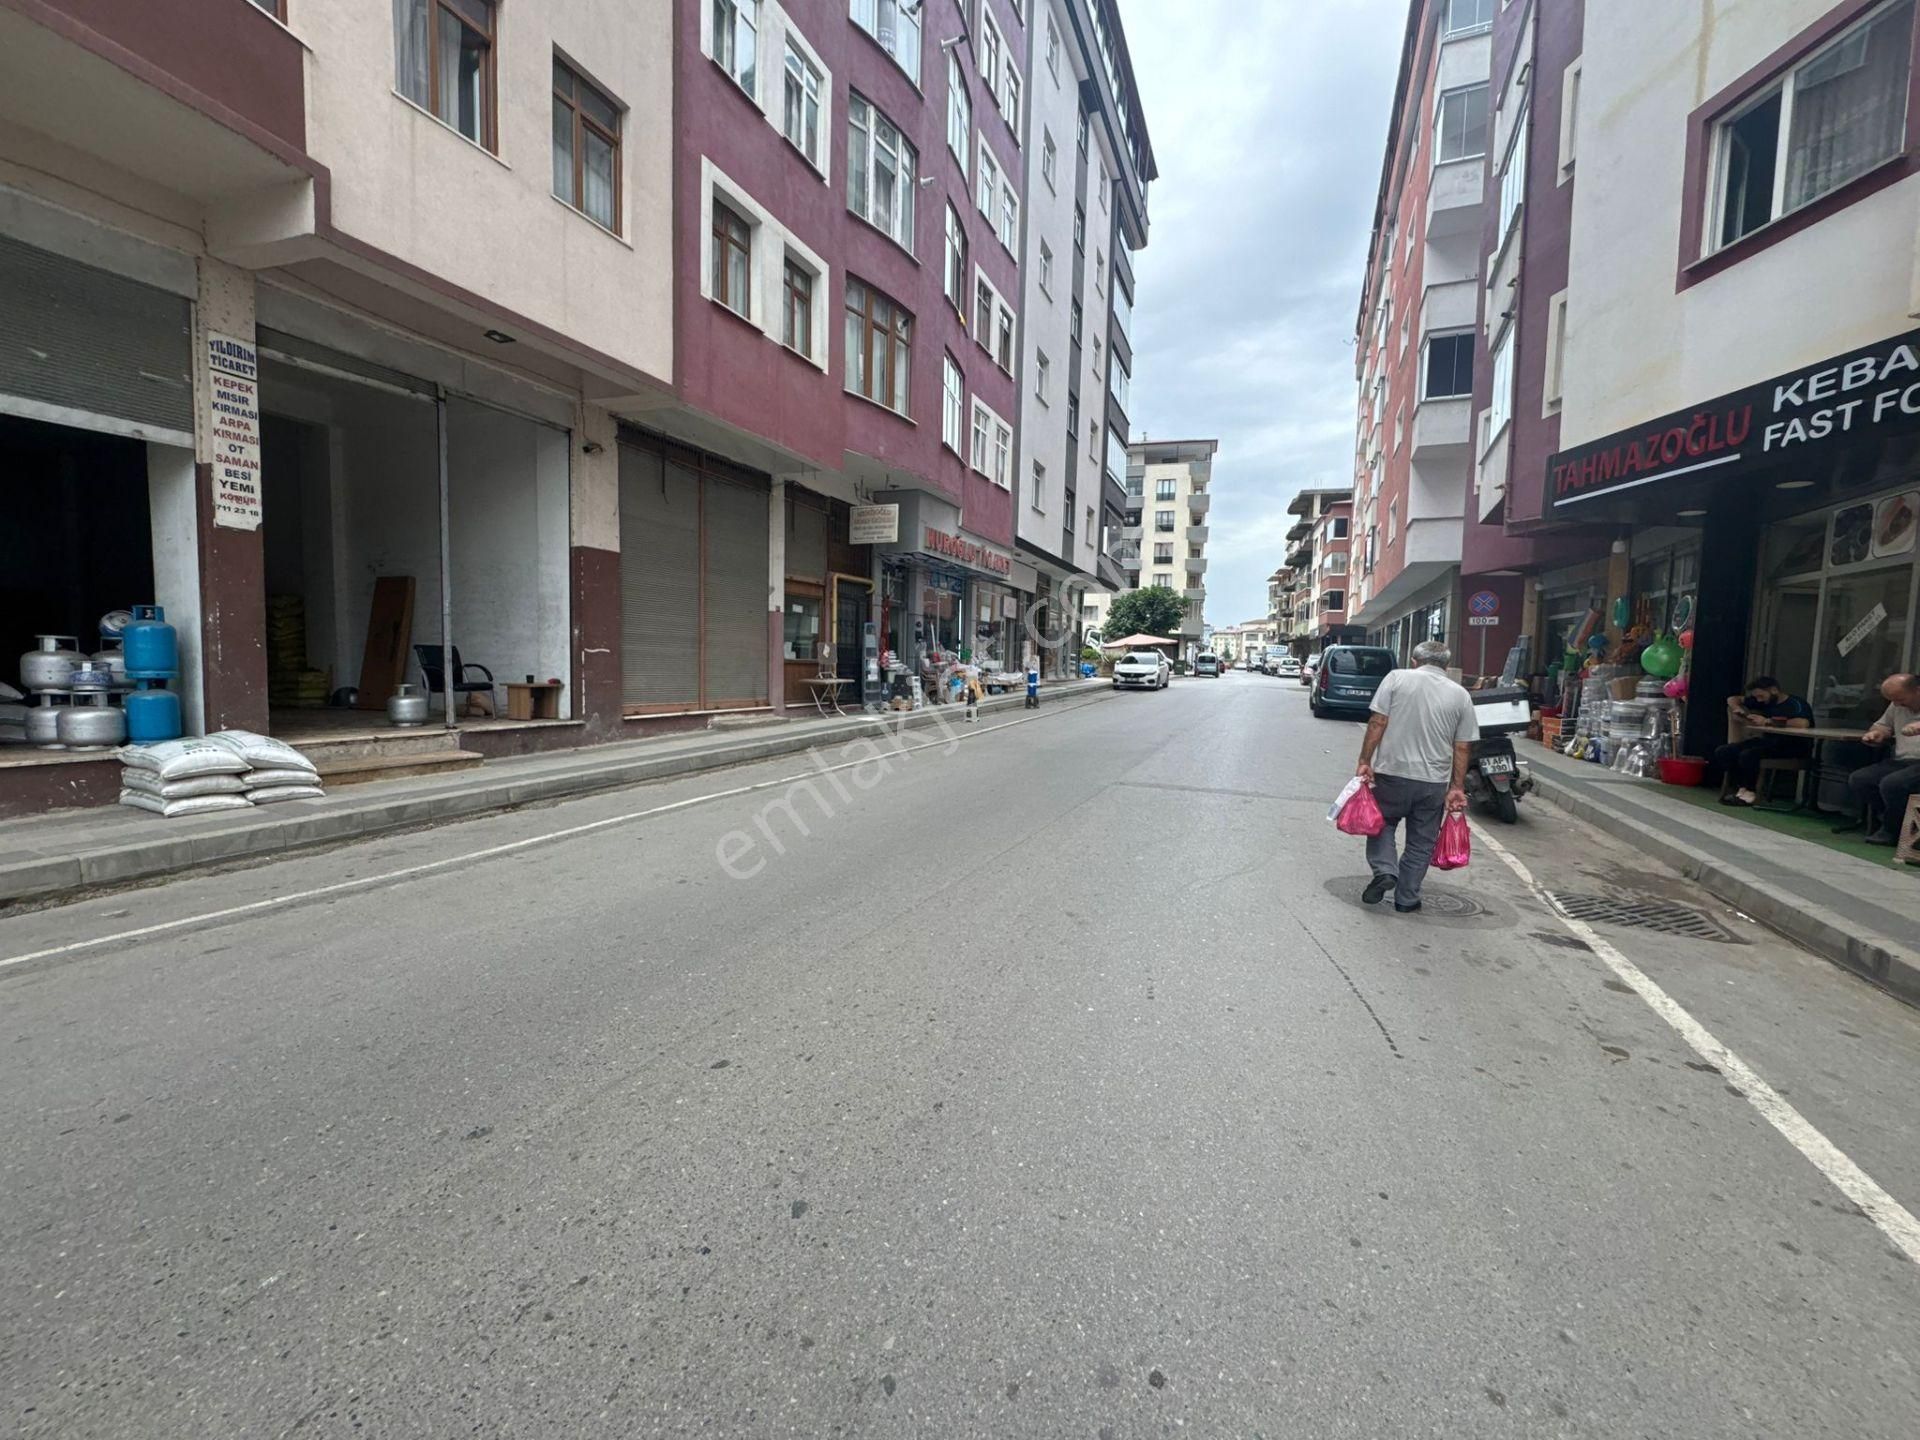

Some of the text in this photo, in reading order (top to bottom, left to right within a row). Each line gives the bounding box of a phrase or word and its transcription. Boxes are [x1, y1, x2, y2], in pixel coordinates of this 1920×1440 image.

[209, 340, 255, 363] YILDIRIM
[210, 354, 255, 376] TİCARET
[213, 375, 254, 395] KEPEK
[1773, 344, 1919, 413] KEBA
[217, 389, 249, 406] MISIR
[212, 400, 258, 420] KIRMASI
[219, 416, 251, 431] ARPA
[1763, 399, 1863, 453] FAST
[213, 427, 259, 446] KIRMASI
[228, 443, 245, 455] OT
[1553, 404, 1753, 495] TAHMAZOĞLU
[215, 453, 259, 470] SAMAN
[1472, 617, 1487, 625] 100
